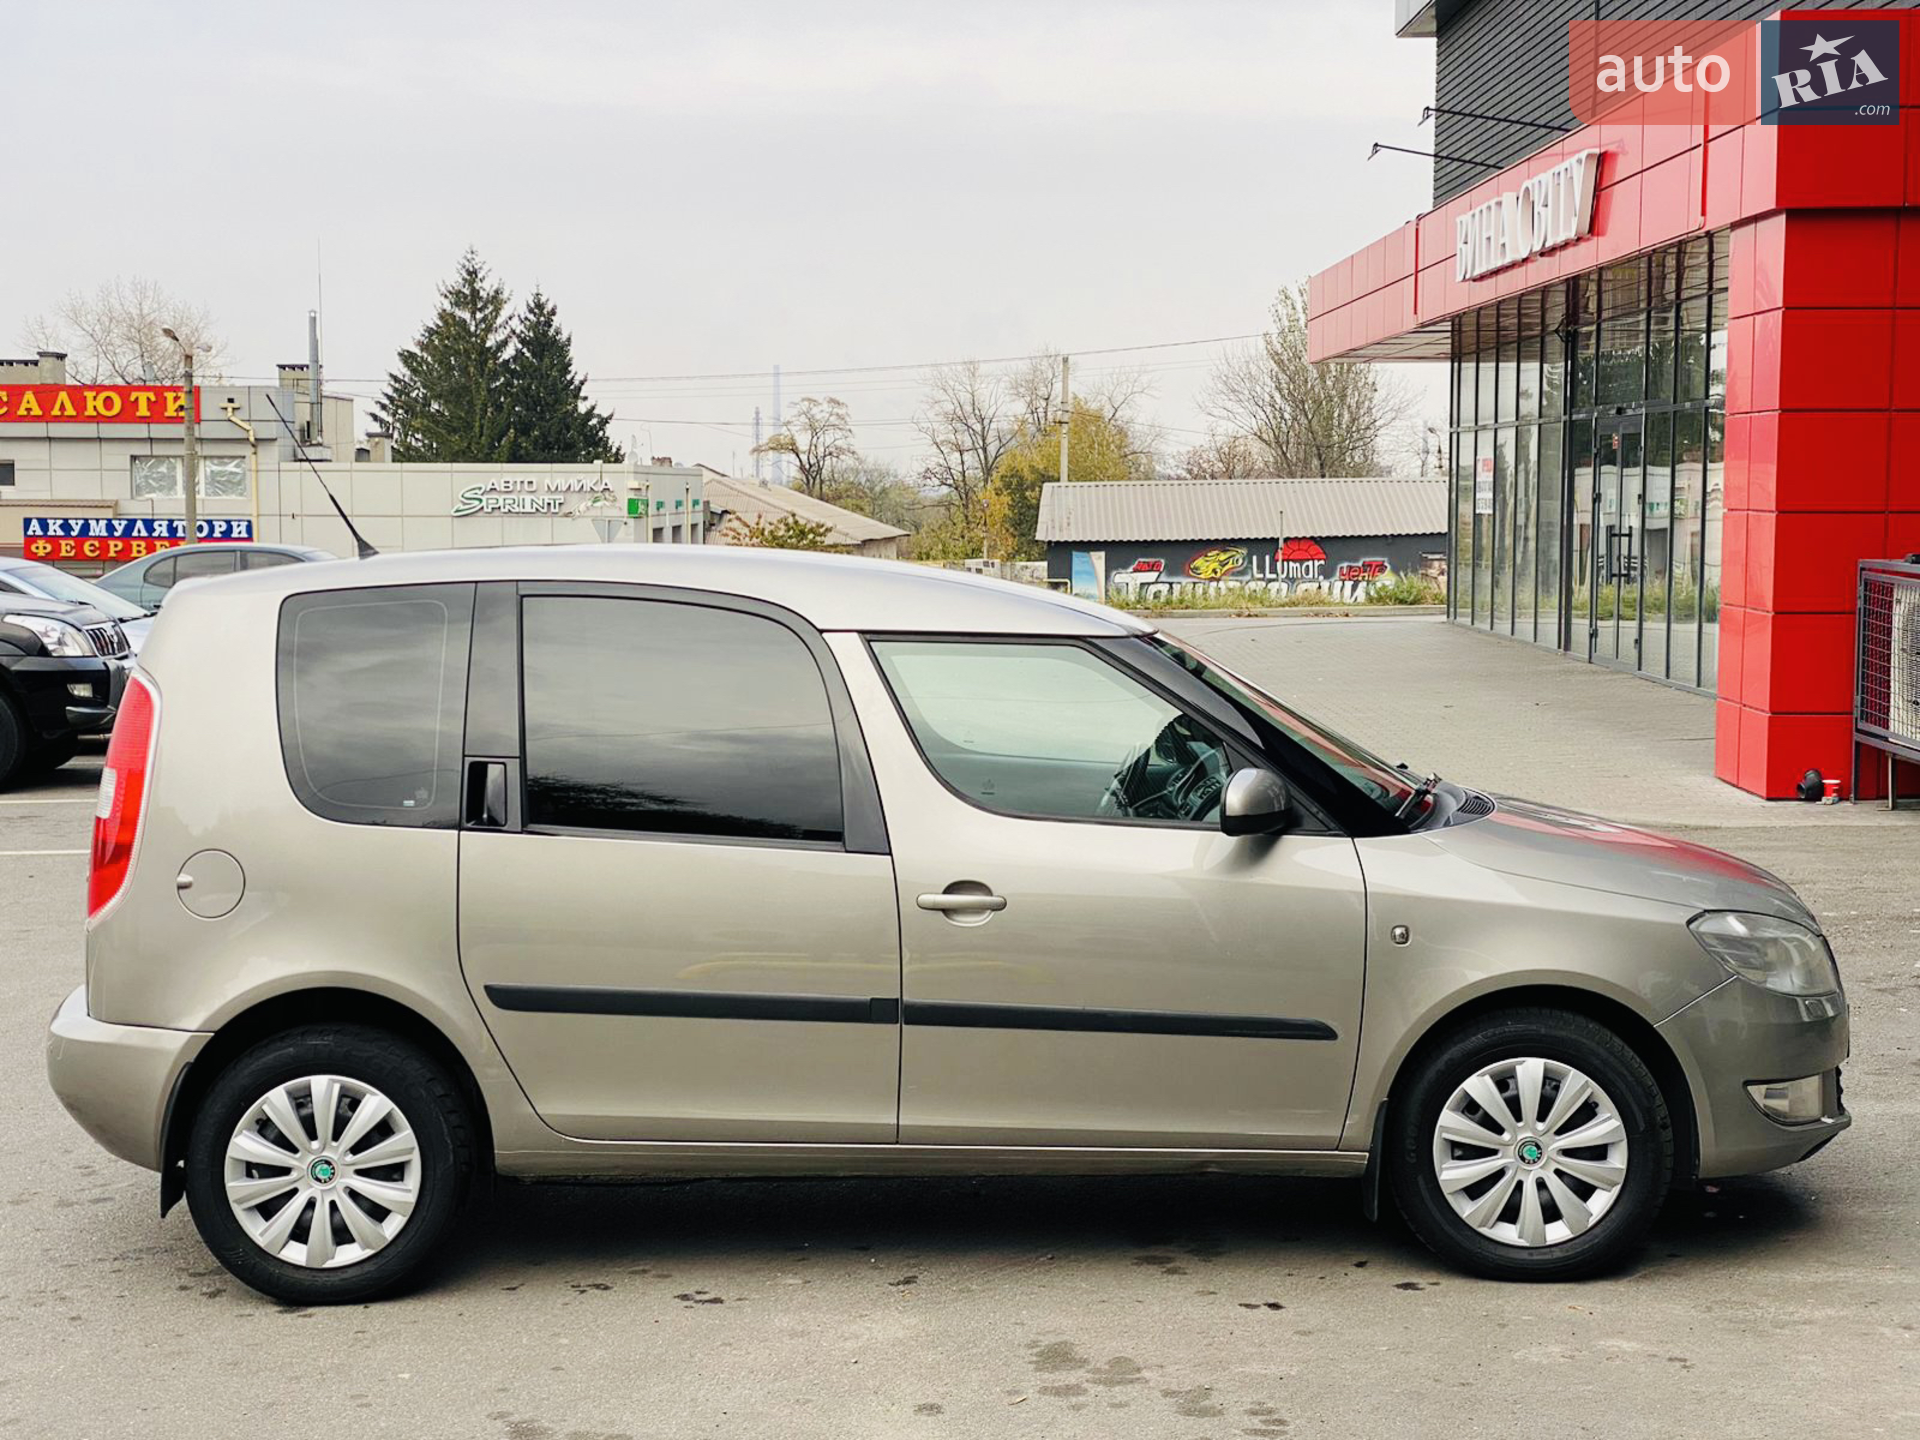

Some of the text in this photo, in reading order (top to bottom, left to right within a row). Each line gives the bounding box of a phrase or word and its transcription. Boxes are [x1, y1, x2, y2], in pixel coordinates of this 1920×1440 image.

[486, 475, 614, 493] АВТО МИЙКА
[27, 518, 249, 538] АКУМУЛЯТОРИ
